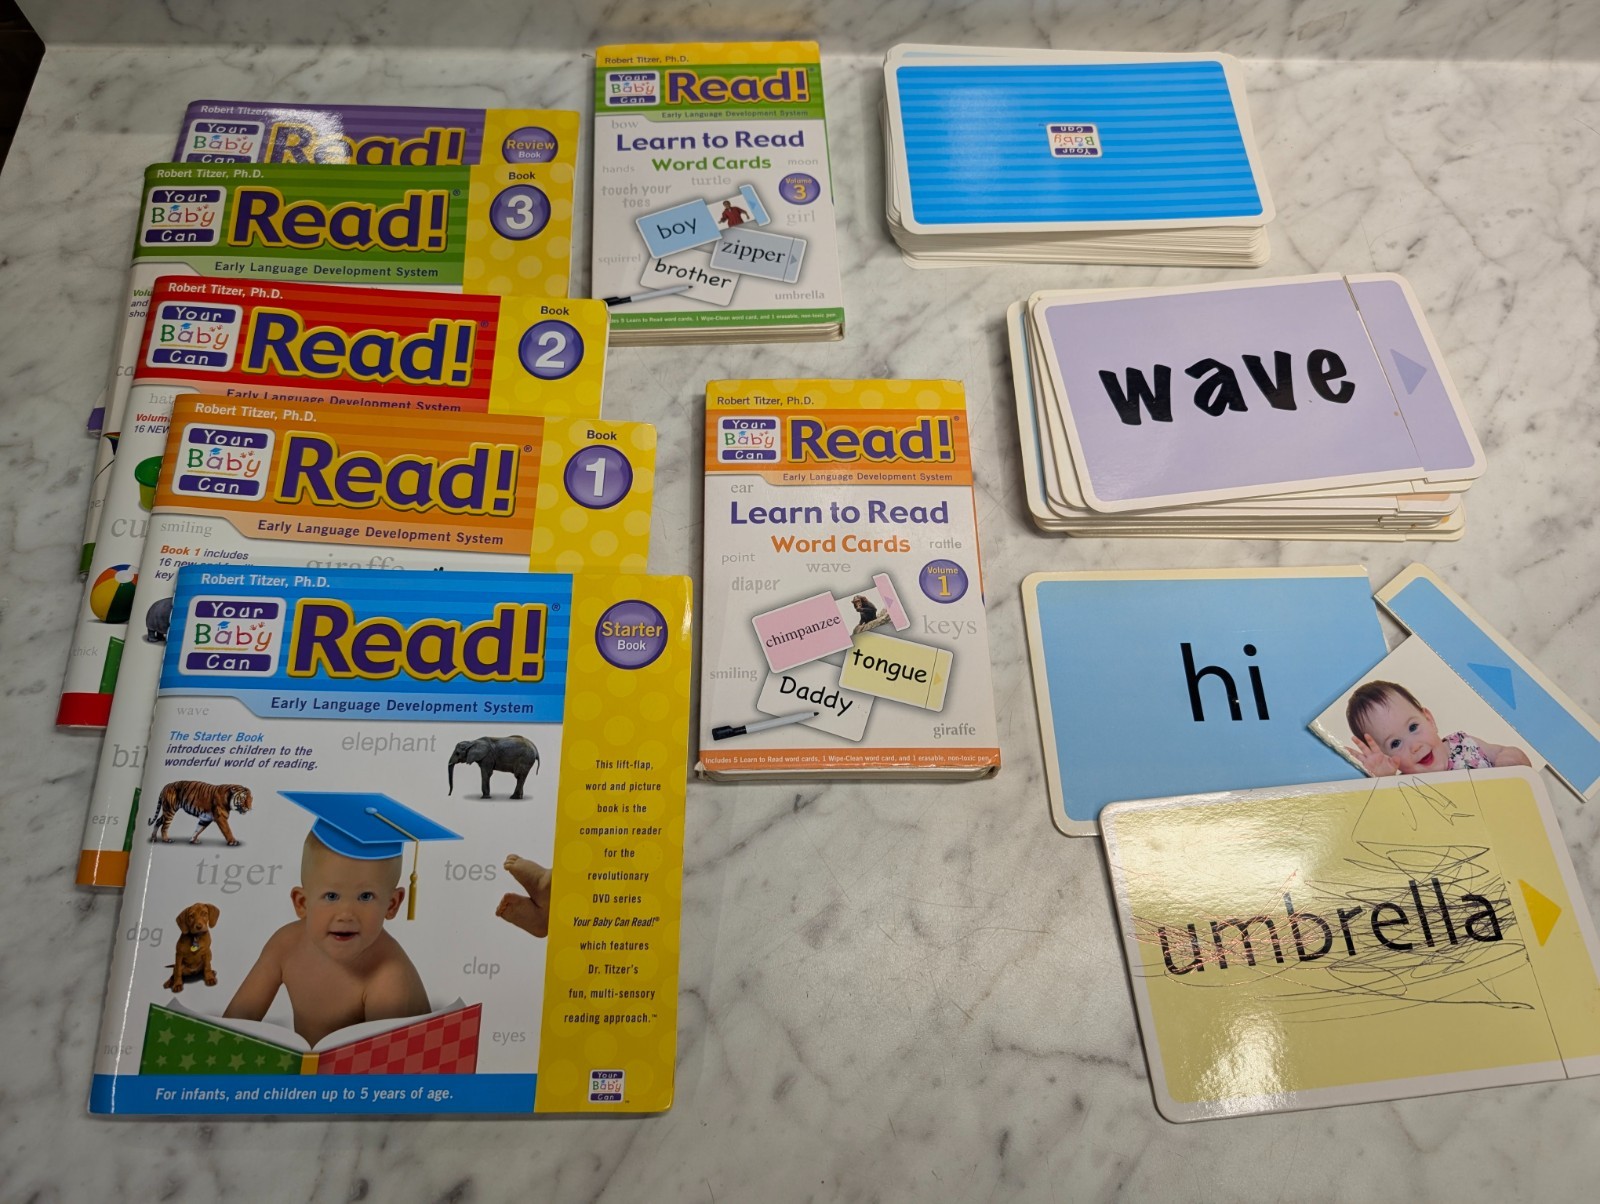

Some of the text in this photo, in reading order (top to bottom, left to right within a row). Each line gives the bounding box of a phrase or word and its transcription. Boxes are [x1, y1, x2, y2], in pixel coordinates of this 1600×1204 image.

[665, 68, 810, 105] Read!
[612, 120, 639, 129] bow
[506, 140, 555, 150] Review
[617, 131, 804, 151] Learn to Read
[1054, 134, 1095, 146] Baby
[519, 151, 541, 159] Book
[788, 158, 818, 166] moon
[602, 165, 635, 174] hands
[652, 156, 771, 171] Word Cards
[691, 175, 731, 186] turtle
[601, 184, 671, 195] touch your
[793, 185, 806, 200] 3
[622, 197, 650, 208] toes
[227, 186, 449, 252] Read!
[506, 195, 534, 230] 3
[787, 211, 815, 225] girl
[657, 218, 696, 240] boy
[598, 254, 641, 264] squirrel
[721, 240, 785, 264] zipper
[655, 258, 731, 289] brother
[775, 291, 824, 300] umbrella
[540, 306, 569, 316] Book
[241, 306, 477, 387] Read!
[535, 331, 567, 369] 2
[1098, 348, 1356, 425] wave
[717, 396, 814, 406] Robert Titzer, Ph.D.
[732, 420, 766, 430] Your
[587, 430, 617, 440] Book
[724, 432, 774, 448] Baby
[786, 416, 954, 463] Read!
[736, 450, 764, 460] Can
[273, 430, 521, 517] Read!
[585, 458, 606, 497] 1
[783, 472, 952, 482] Early Language Development System
[730, 484, 754, 494] ear
[731, 500, 948, 524] Learn to Read
[160, 520, 212, 538] smiling
[772, 535, 910, 553] Word Cards
[930, 538, 962, 548] rattle
[160, 546, 249, 560] Book 1 includes
[722, 552, 756, 565] point
[806, 562, 850, 573] wave
[928, 566, 958, 575] Volume
[155, 570, 174, 582] key
[201, 573, 330, 588] Robert Titzer, Ph.D.
[731, 576, 780, 593] diaper
[938, 576, 950, 596] 1
[211, 603, 263, 618] Your
[602, 621, 662, 638] Starter
[766, 615, 841, 648] chimpanzee
[923, 616, 977, 640] keys
[194, 623, 272, 652] Baby
[286, 597, 549, 683] Read!
[617, 639, 646, 651] Book
[206, 654, 250, 670] Can
[852, 648, 927, 683] tongue
[710, 668, 758, 680] smiling
[1180, 642, 1271, 722] hi
[780, 676, 852, 716] Daddy
[177, 706, 209, 716] wave
[271, 697, 534, 715] Early Language Development System
[170, 731, 264, 742] The Starter Book
[933, 723, 976, 738] giraffe
[166, 744, 313, 756] introduces children to the
[342, 732, 436, 756] elephant
[164, 757, 318, 771] wonderful world of reading.
[596, 760, 653, 771] This lift-flap,
[585, 782, 661, 792] word and picture
[597, 804, 646, 813] book is the
[92, 814, 119, 825] ears
[580, 827, 661, 836] companion reader
[604, 849, 634, 858] for the
[196, 854, 282, 894] tiger
[445, 860, 497, 881] toes
[588, 871, 649, 882] revolutionary
[593, 894, 641, 904] DVD series
[573, 917, 591, 926] Your
[593, 917, 613, 928] Baby
[614, 917, 629, 926] Can
[1157, 877, 1503, 976] umbrella
[126, 922, 163, 947] dog
[580, 941, 649, 950] which features
[463, 957, 501, 979] clap
[588, 965, 638, 974] Dr. Titzer's
[569, 989, 655, 999] fun, multi-sensory
[564, 1013, 600, 1024] reading
[493, 1031, 526, 1045] eyes
[592, 1080, 621, 1092] Baby
[155, 1088, 453, 1101] For infants, and children up to 5 years of age.
